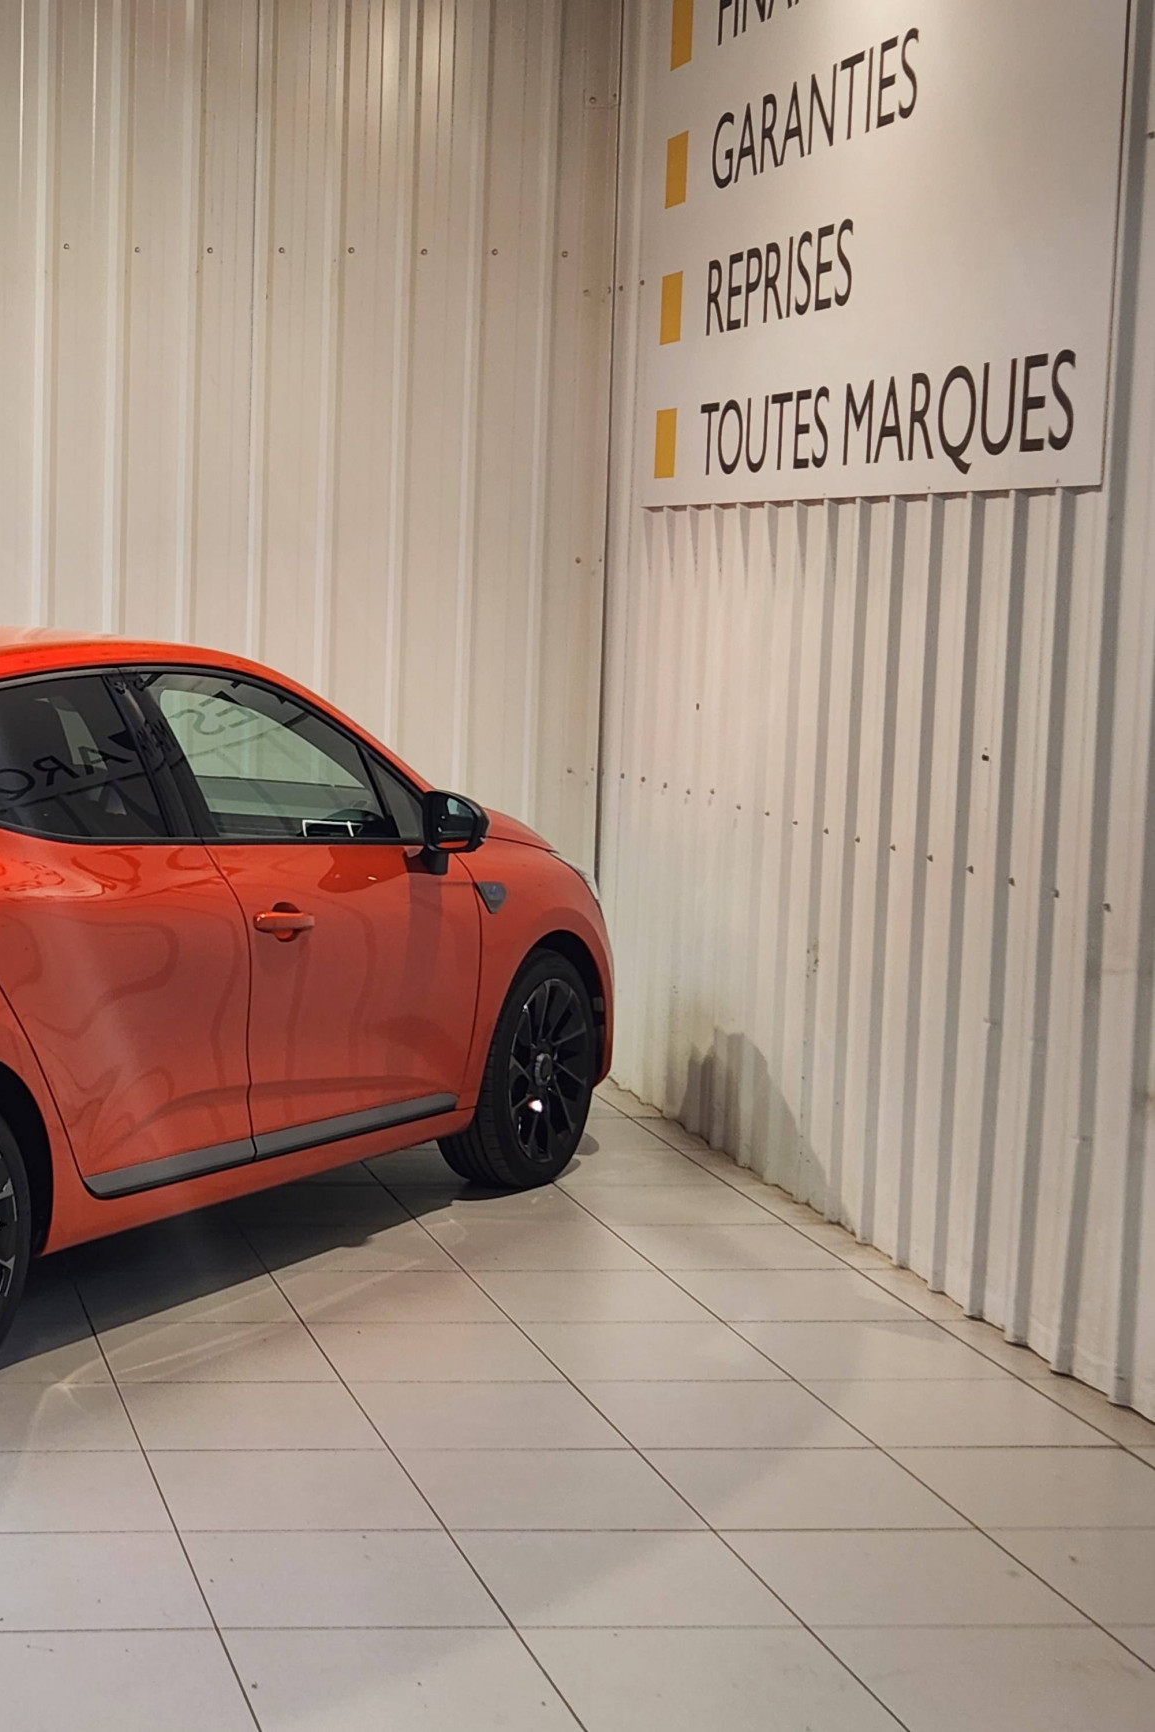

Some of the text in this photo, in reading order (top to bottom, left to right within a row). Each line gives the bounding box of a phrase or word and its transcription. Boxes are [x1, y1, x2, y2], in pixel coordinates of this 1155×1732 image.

[712, 27, 920, 189] GARANTIES
[705, 218, 854, 336] REPRISES
[700, 349, 1077, 476] TOUTES MARQUES
